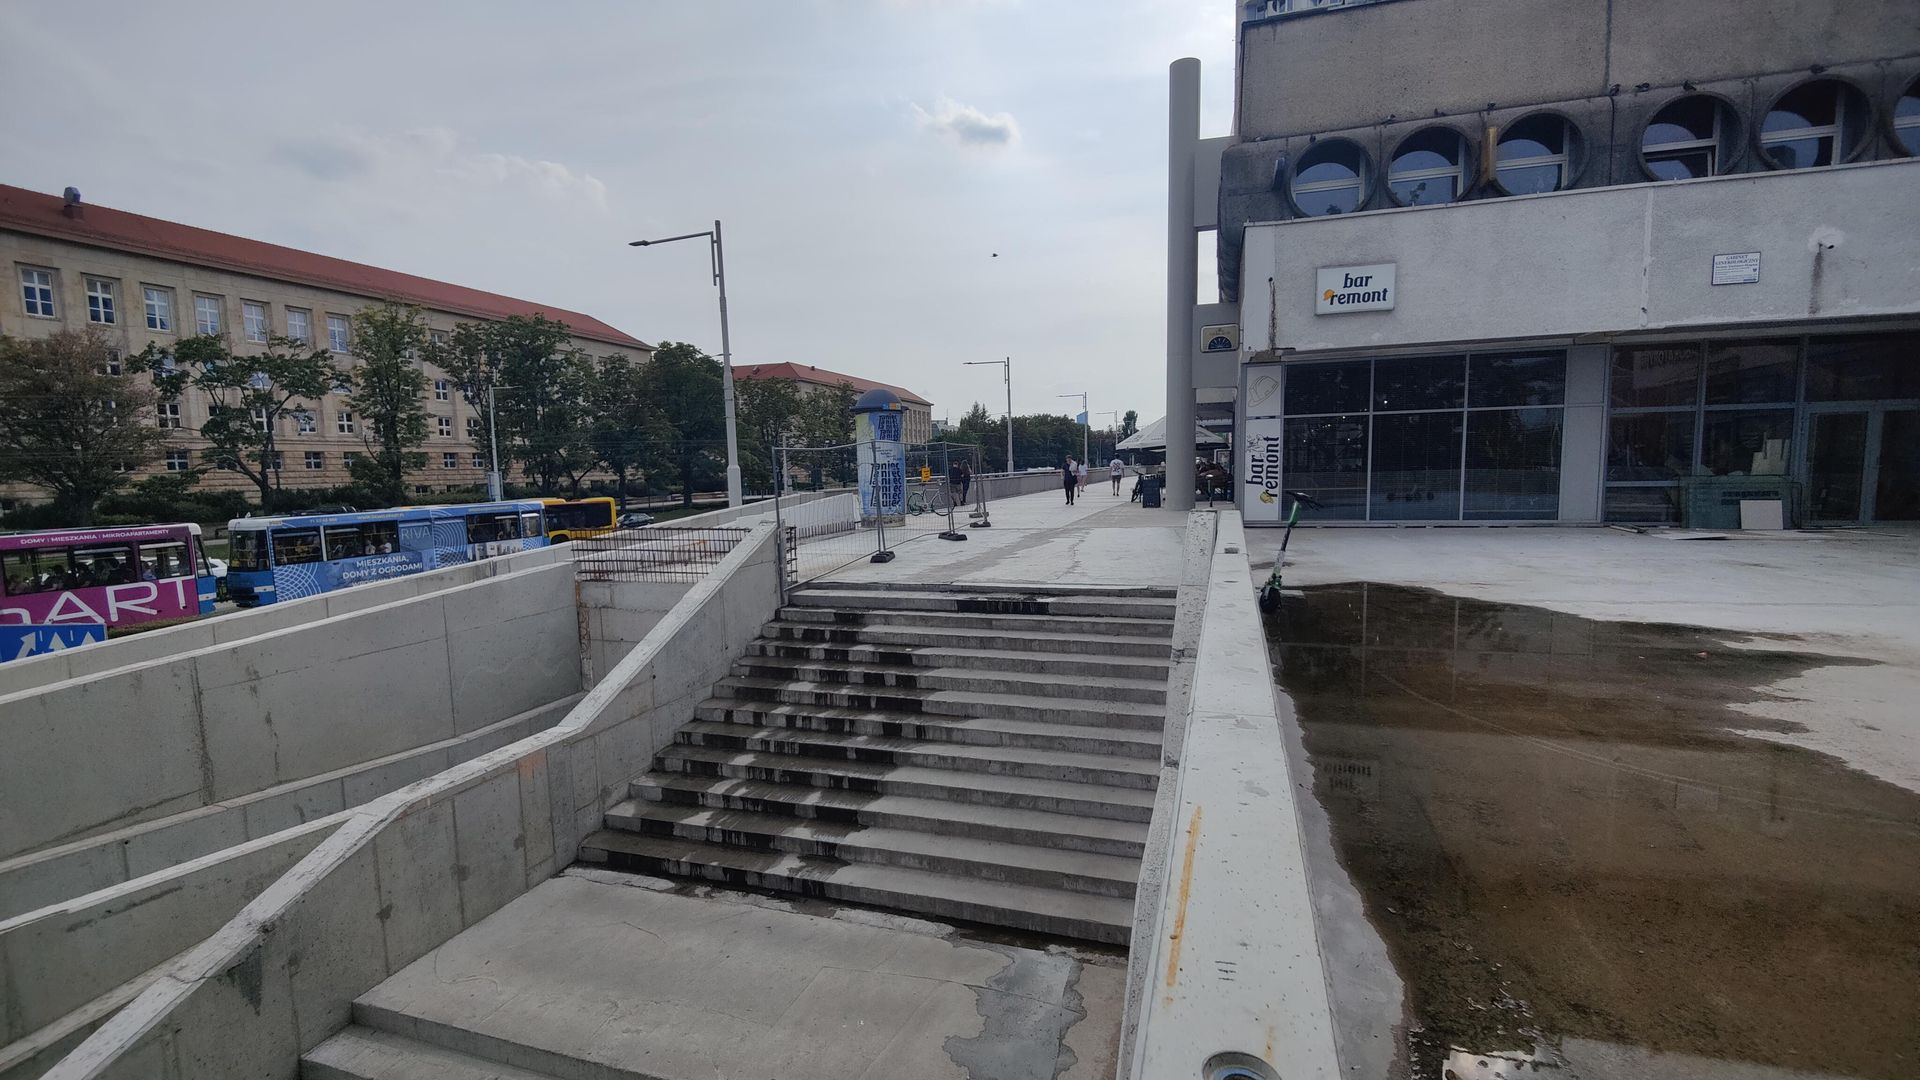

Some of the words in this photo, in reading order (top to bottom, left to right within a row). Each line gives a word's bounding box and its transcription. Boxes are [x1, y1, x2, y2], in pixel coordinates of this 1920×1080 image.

[1343, 272, 1373, 288] bar
[1329, 287, 1388, 305] remont
[1246, 455, 1264, 485] bar
[1263, 436, 1280, 498] remont
[20, 537, 45, 545] DOMY
[51, 534, 97, 542] MIESZKANIA
[102, 529, 169, 539] MIKROAPARTAMENTY
[356, 555, 409, 568] MIESZKANIA,
[342, 570, 369, 580] DOMY
[378, 562, 423, 574] OGRODAMI
